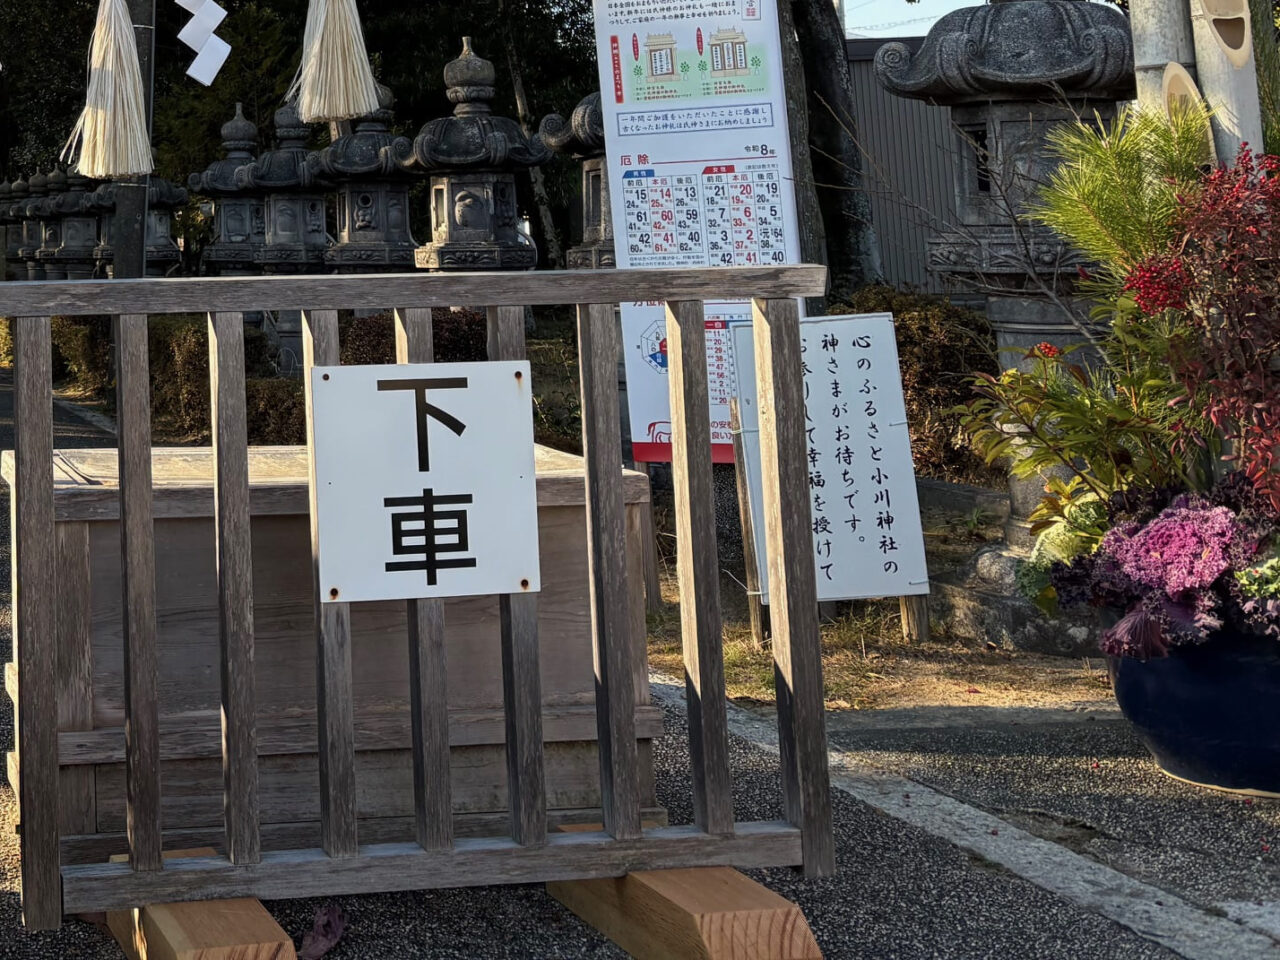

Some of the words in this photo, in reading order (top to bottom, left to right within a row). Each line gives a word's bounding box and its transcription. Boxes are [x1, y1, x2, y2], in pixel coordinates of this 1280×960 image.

[620, 154, 649, 166] 厄除
[377, 377, 476, 585] 下車
[821, 333, 865, 542] 神さまがお待ちです。
[852, 335, 899, 574] 心のふるさと小川神社の
